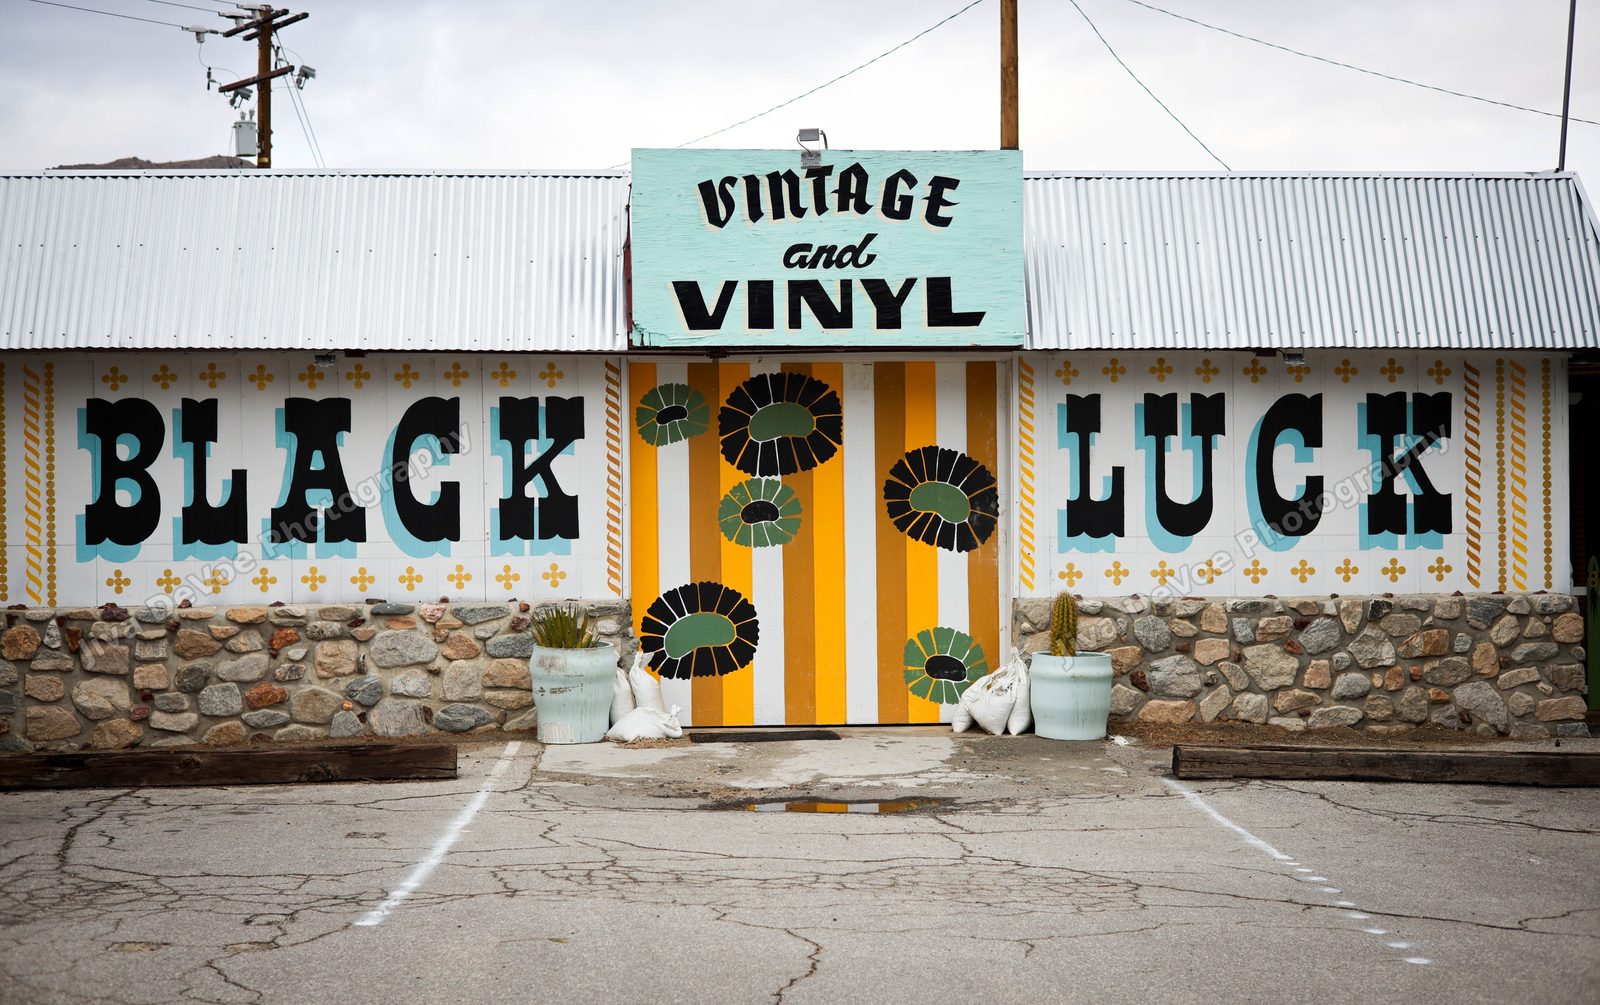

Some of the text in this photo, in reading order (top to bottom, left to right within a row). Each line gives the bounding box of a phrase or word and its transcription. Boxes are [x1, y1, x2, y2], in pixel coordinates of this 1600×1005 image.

[697, 162, 960, 228] VINTAGE
[783, 233, 878, 269] and
[671, 277, 986, 330] VINYL
[84, 396, 585, 547] BLACK
[1065, 392, 1453, 540] LUCK
